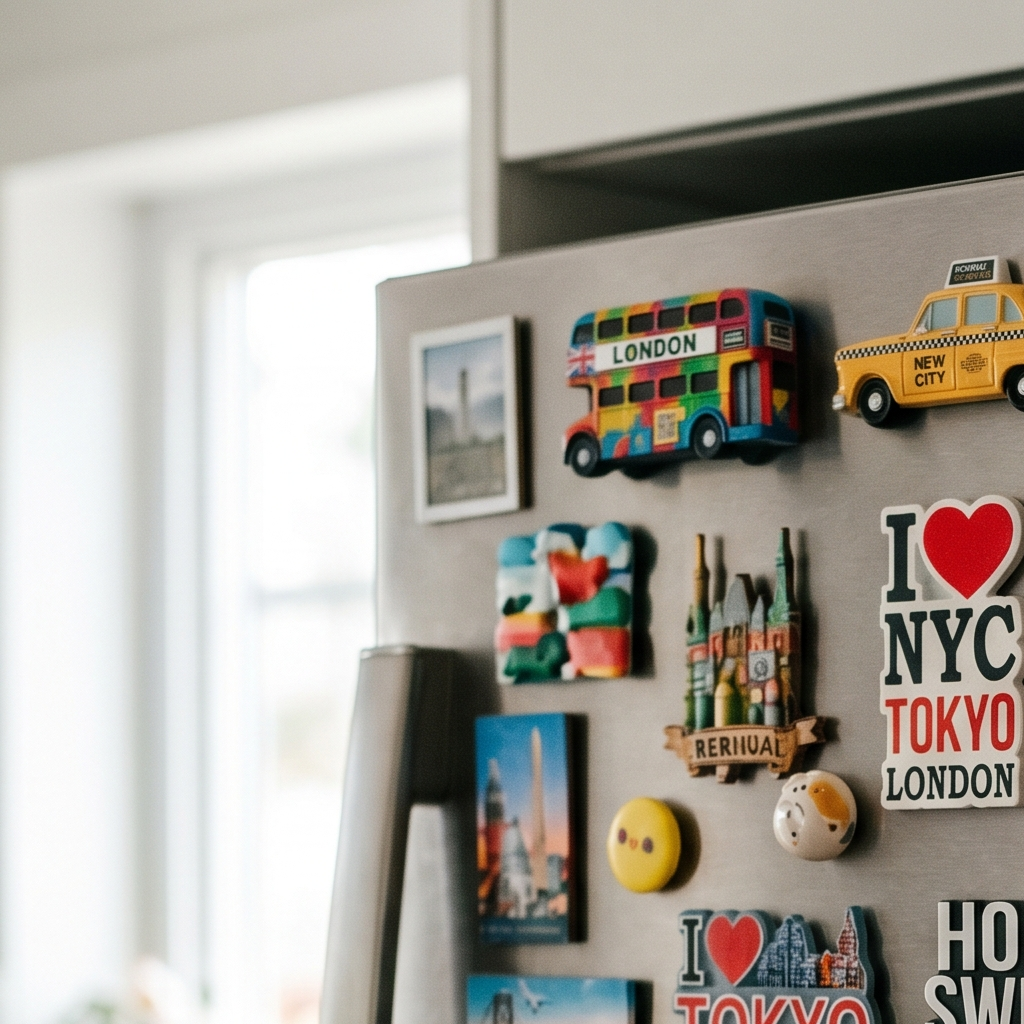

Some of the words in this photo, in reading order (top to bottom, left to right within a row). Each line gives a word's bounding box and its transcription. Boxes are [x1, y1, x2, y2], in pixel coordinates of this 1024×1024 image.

[613, 333, 696, 364] LONDON
[914, 354, 946, 371] NEW
[914, 371, 946, 387] CITY
[886, 512, 916, 603] I
[884, 604, 1016, 686] NYC
[885, 692, 1015, 754] TOKYO
[886, 763, 1015, 801] LONDON
[681, 916, 703, 985] I
